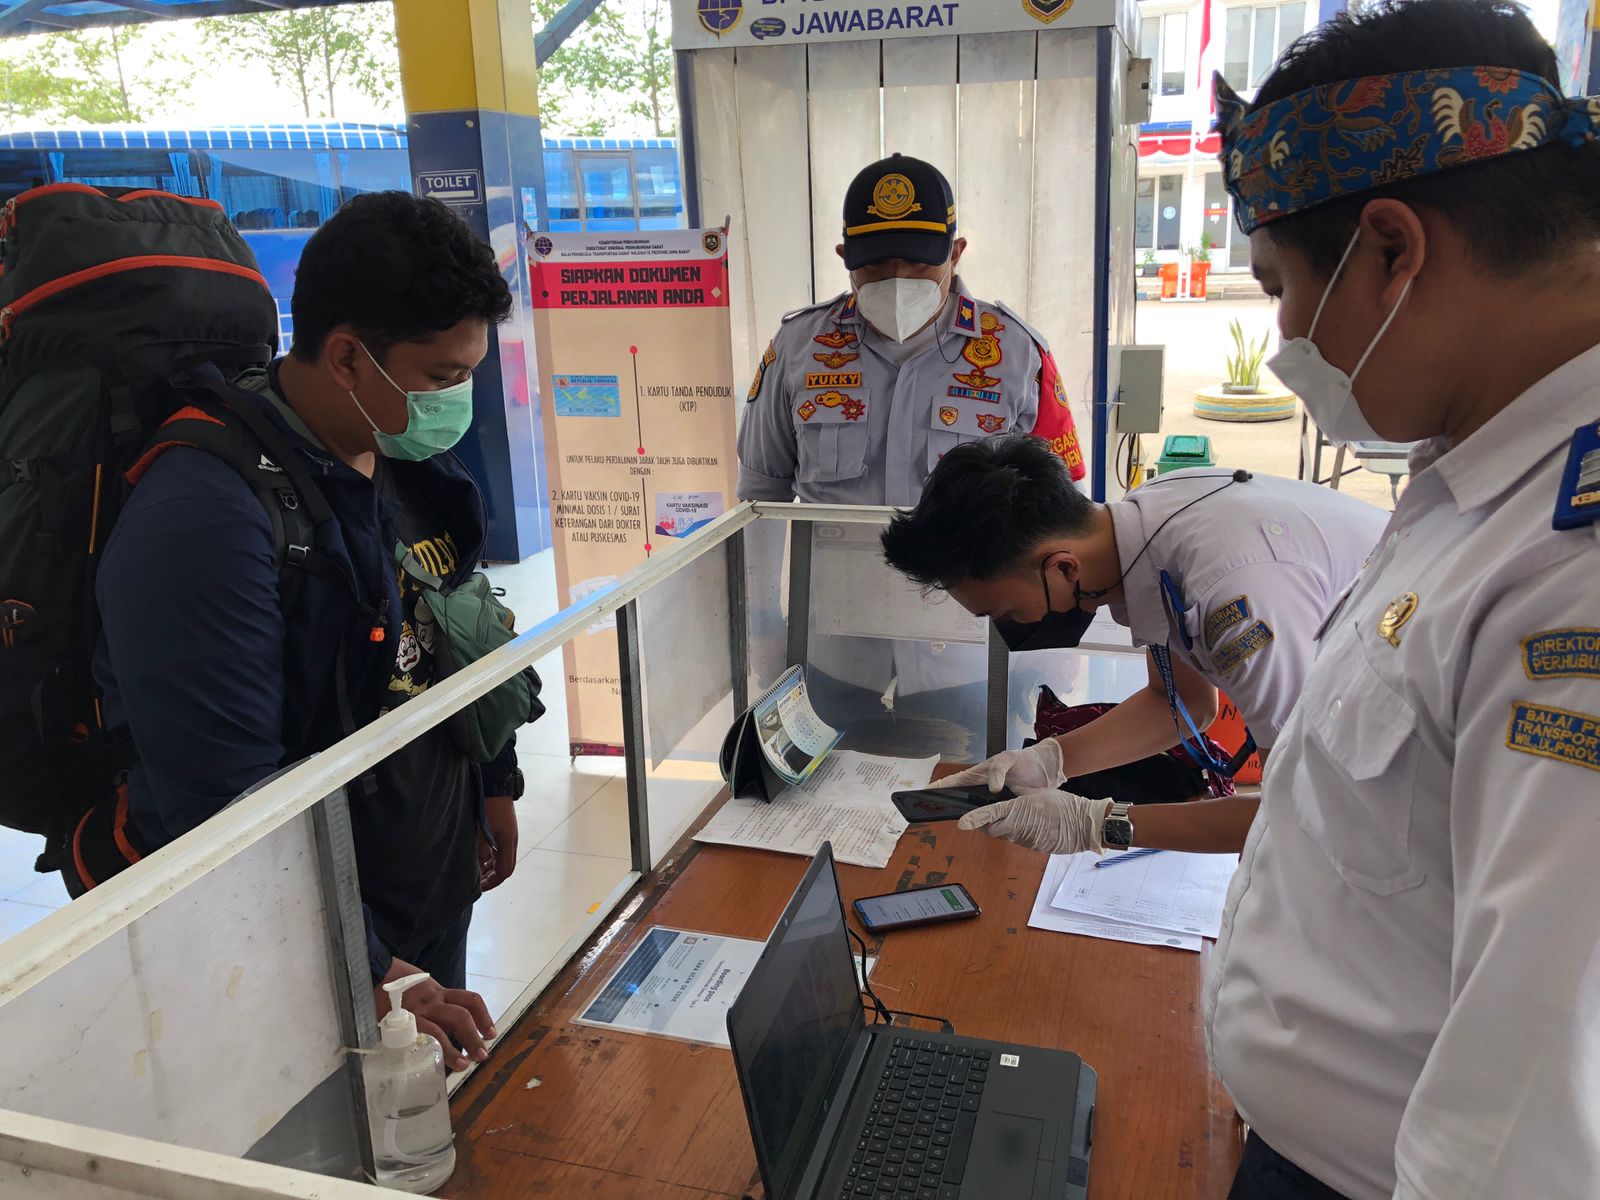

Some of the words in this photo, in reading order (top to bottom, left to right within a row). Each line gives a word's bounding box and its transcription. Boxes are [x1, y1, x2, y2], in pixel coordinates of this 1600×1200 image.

[791, 3, 960, 36] JAWABARAT
[425, 176, 472, 189] TOILET
[561, 268, 624, 284] SIAPKAN
[629, 266, 701, 283] DOKUMEN
[561, 289, 658, 305] PERJALANAN
[663, 288, 704, 304] ANDA
[808, 374, 858, 385] YUKKY
[647, 386, 669, 397] KARTU
[671, 386, 694, 397] TANDA
[695, 385, 732, 398] PENDUDUK
[566, 455, 584, 464] UNTUK
[629, 467, 651, 476] DENGAN
[560, 490, 582, 501] KARTU
[584, 490, 608, 501] VAKSIN
[609, 491, 640, 502] COVID-19
[556, 504, 585, 515] MINIMAL
[586, 505, 606, 515] DOSIS
[620, 506, 640, 516] SURAT
[554, 518, 597, 529] KETERANGAN
[598, 519, 614, 529] DARI
[615, 519, 641, 529] DOKTER
[571, 531, 589, 542] ATAU
[590, 532, 628, 543] PUSKESMAS
[1526, 709, 1574, 730] BALAI
[1516, 719, 1600, 748] TRANSPOR
